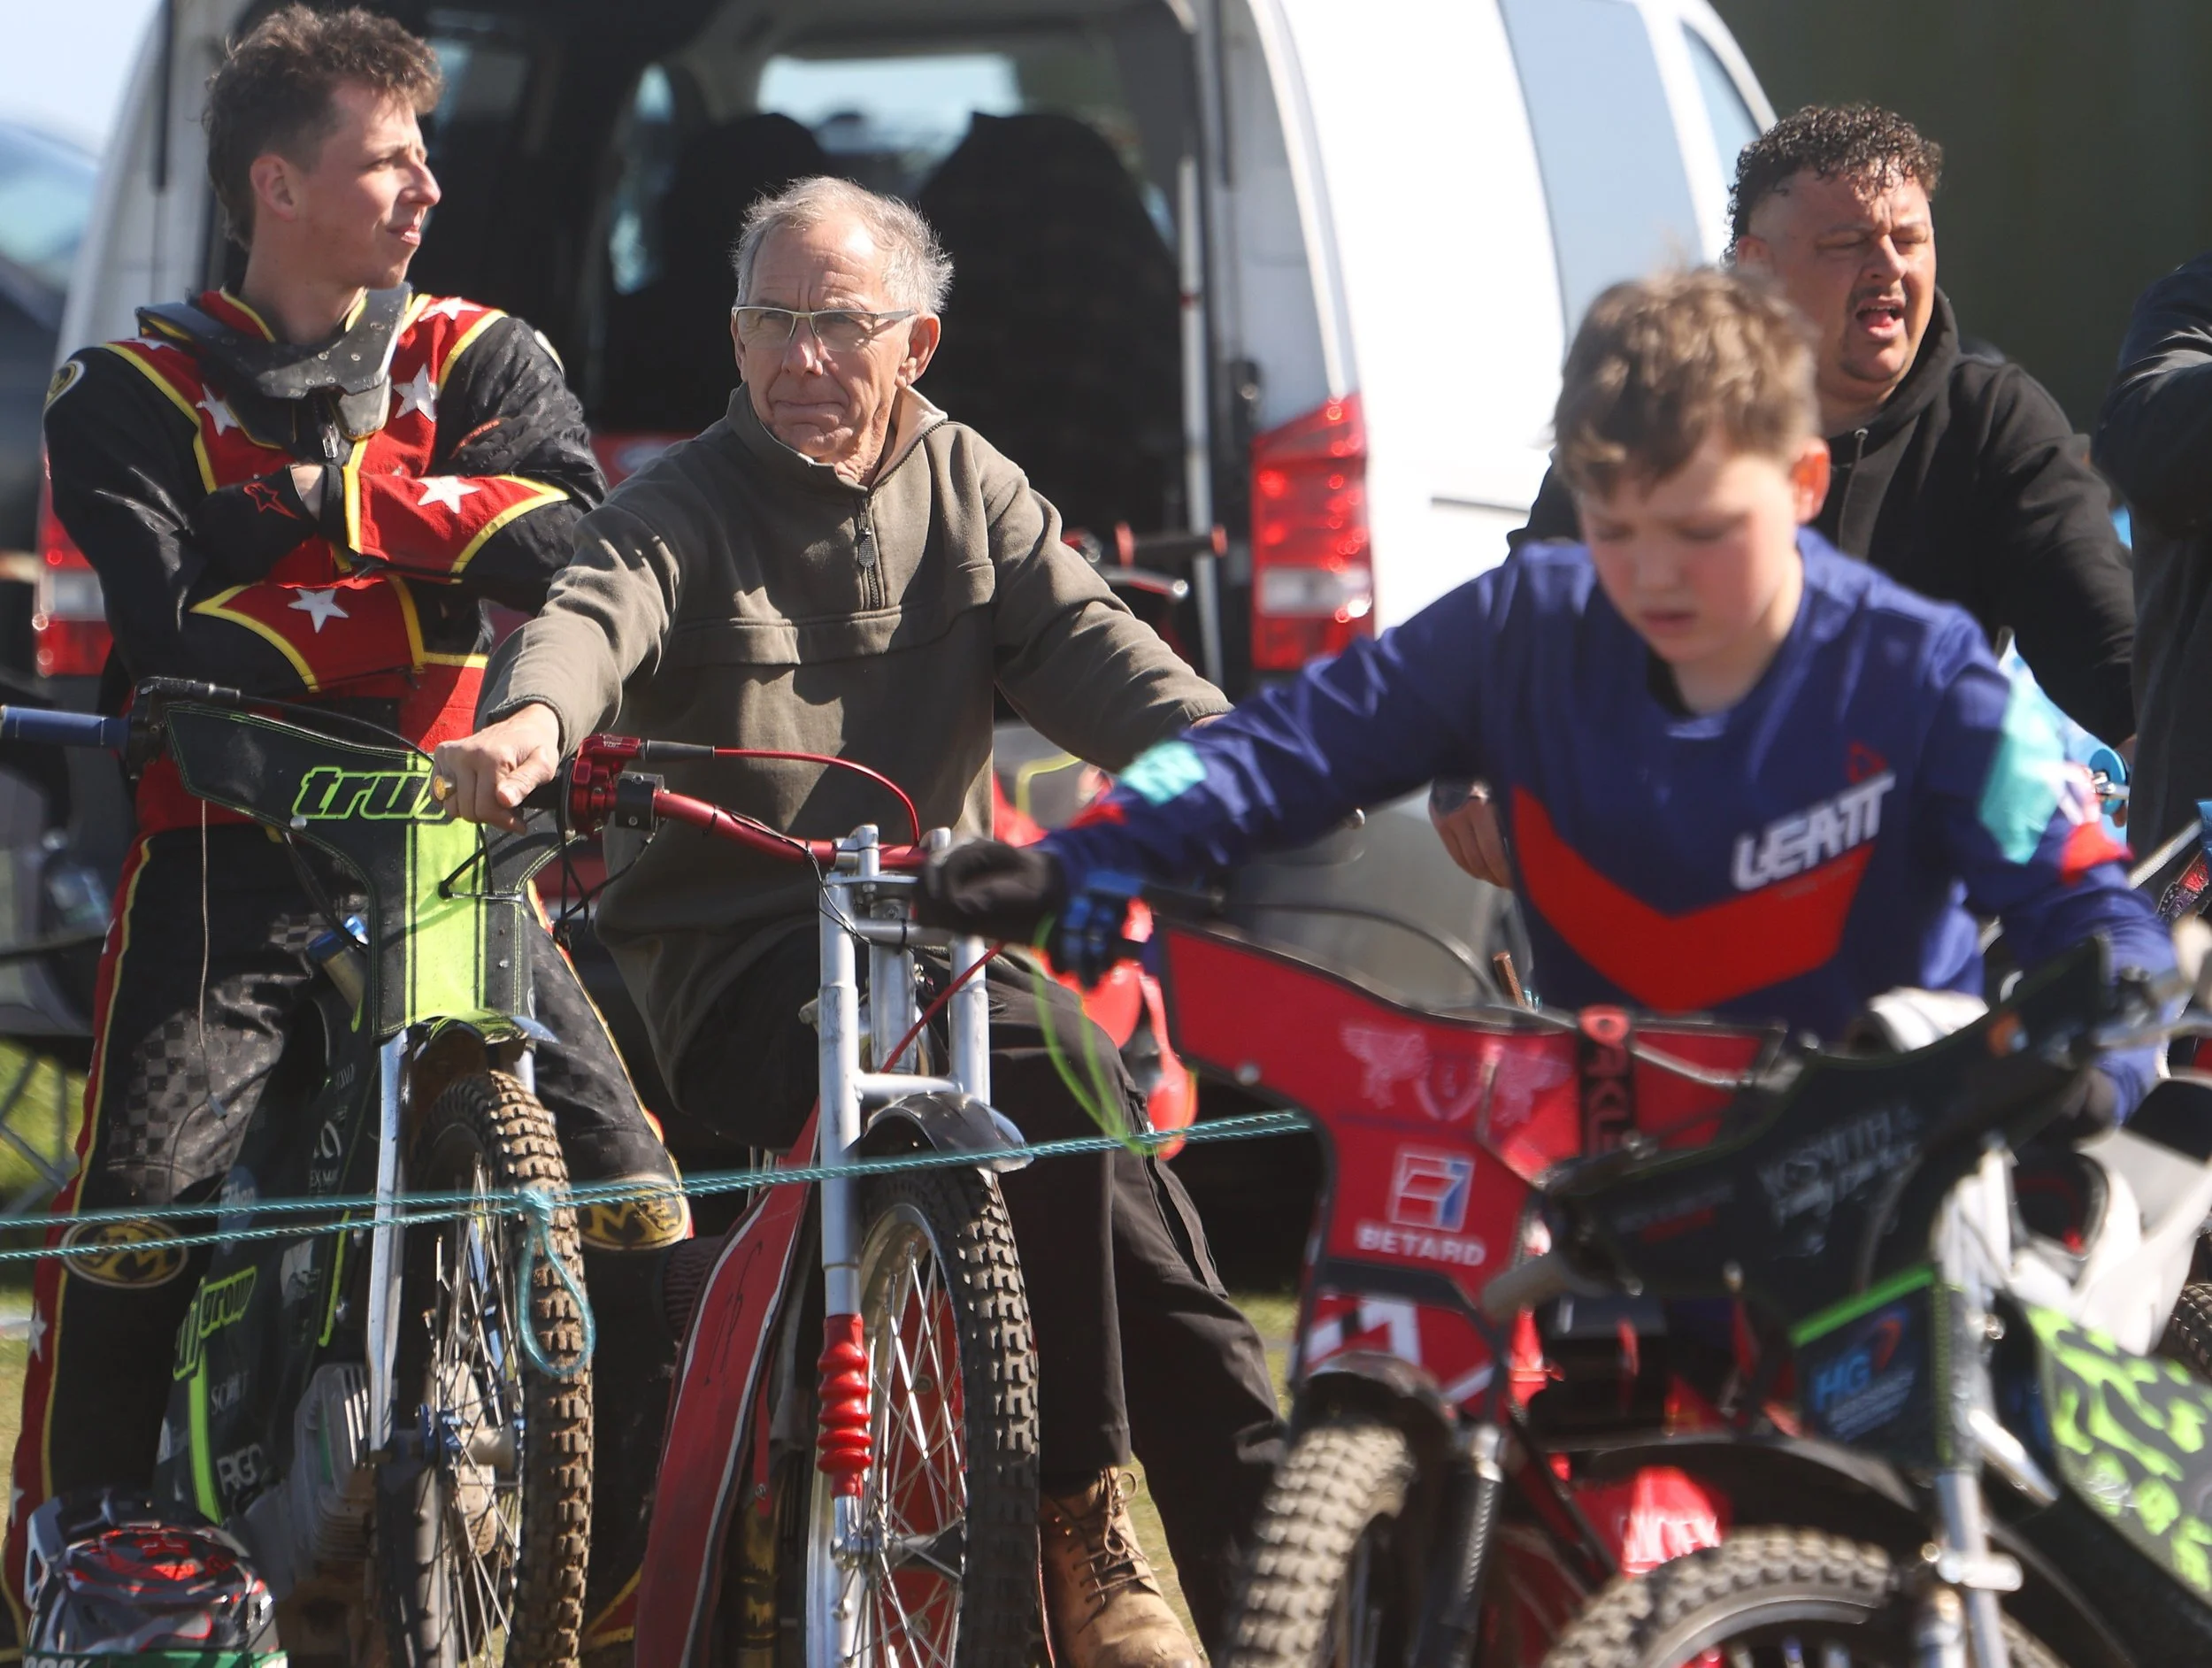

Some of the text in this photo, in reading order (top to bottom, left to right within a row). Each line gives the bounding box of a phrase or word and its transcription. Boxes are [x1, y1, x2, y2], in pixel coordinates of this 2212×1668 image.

[291, 766, 447, 820] tru
[1732, 772, 1897, 893] LEATT
[1356, 1223, 1487, 1267] BETARD
